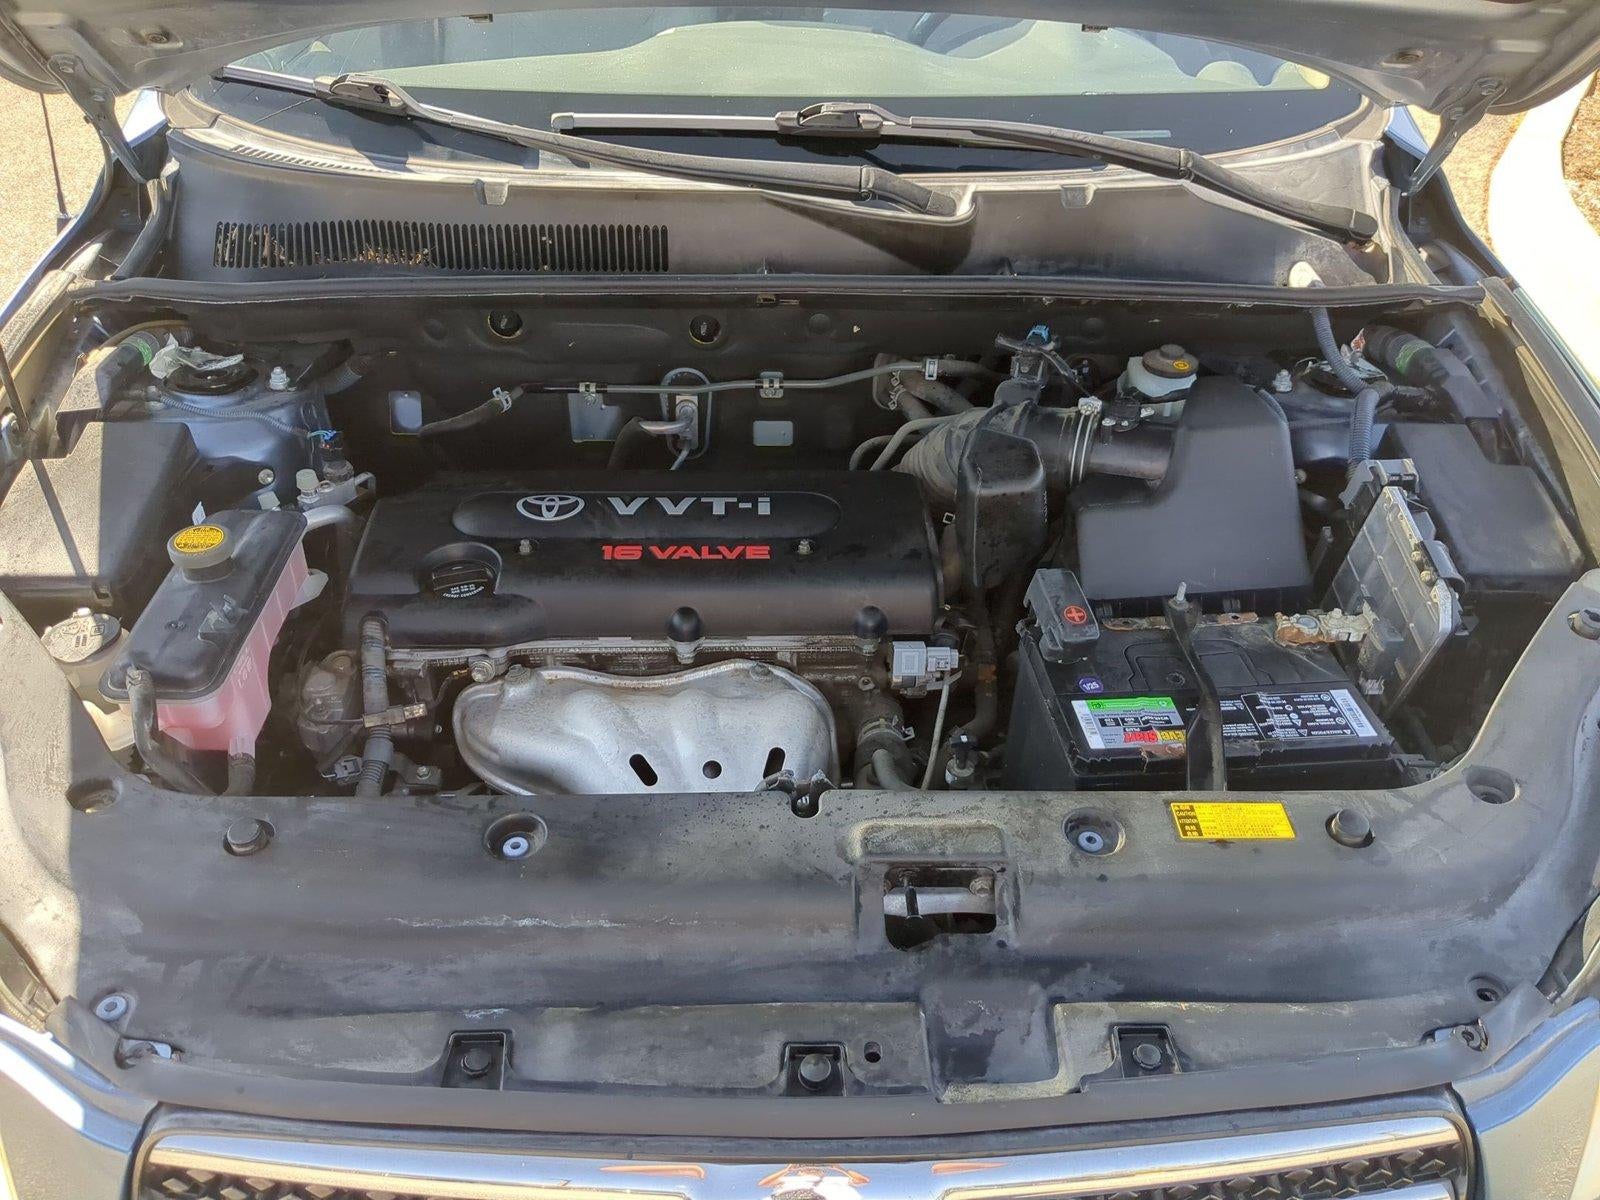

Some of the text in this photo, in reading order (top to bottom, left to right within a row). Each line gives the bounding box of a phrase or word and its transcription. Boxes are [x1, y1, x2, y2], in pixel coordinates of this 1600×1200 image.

[607, 496, 771, 515] VVT-i
[602, 545, 770, 560] 16 VALVE
